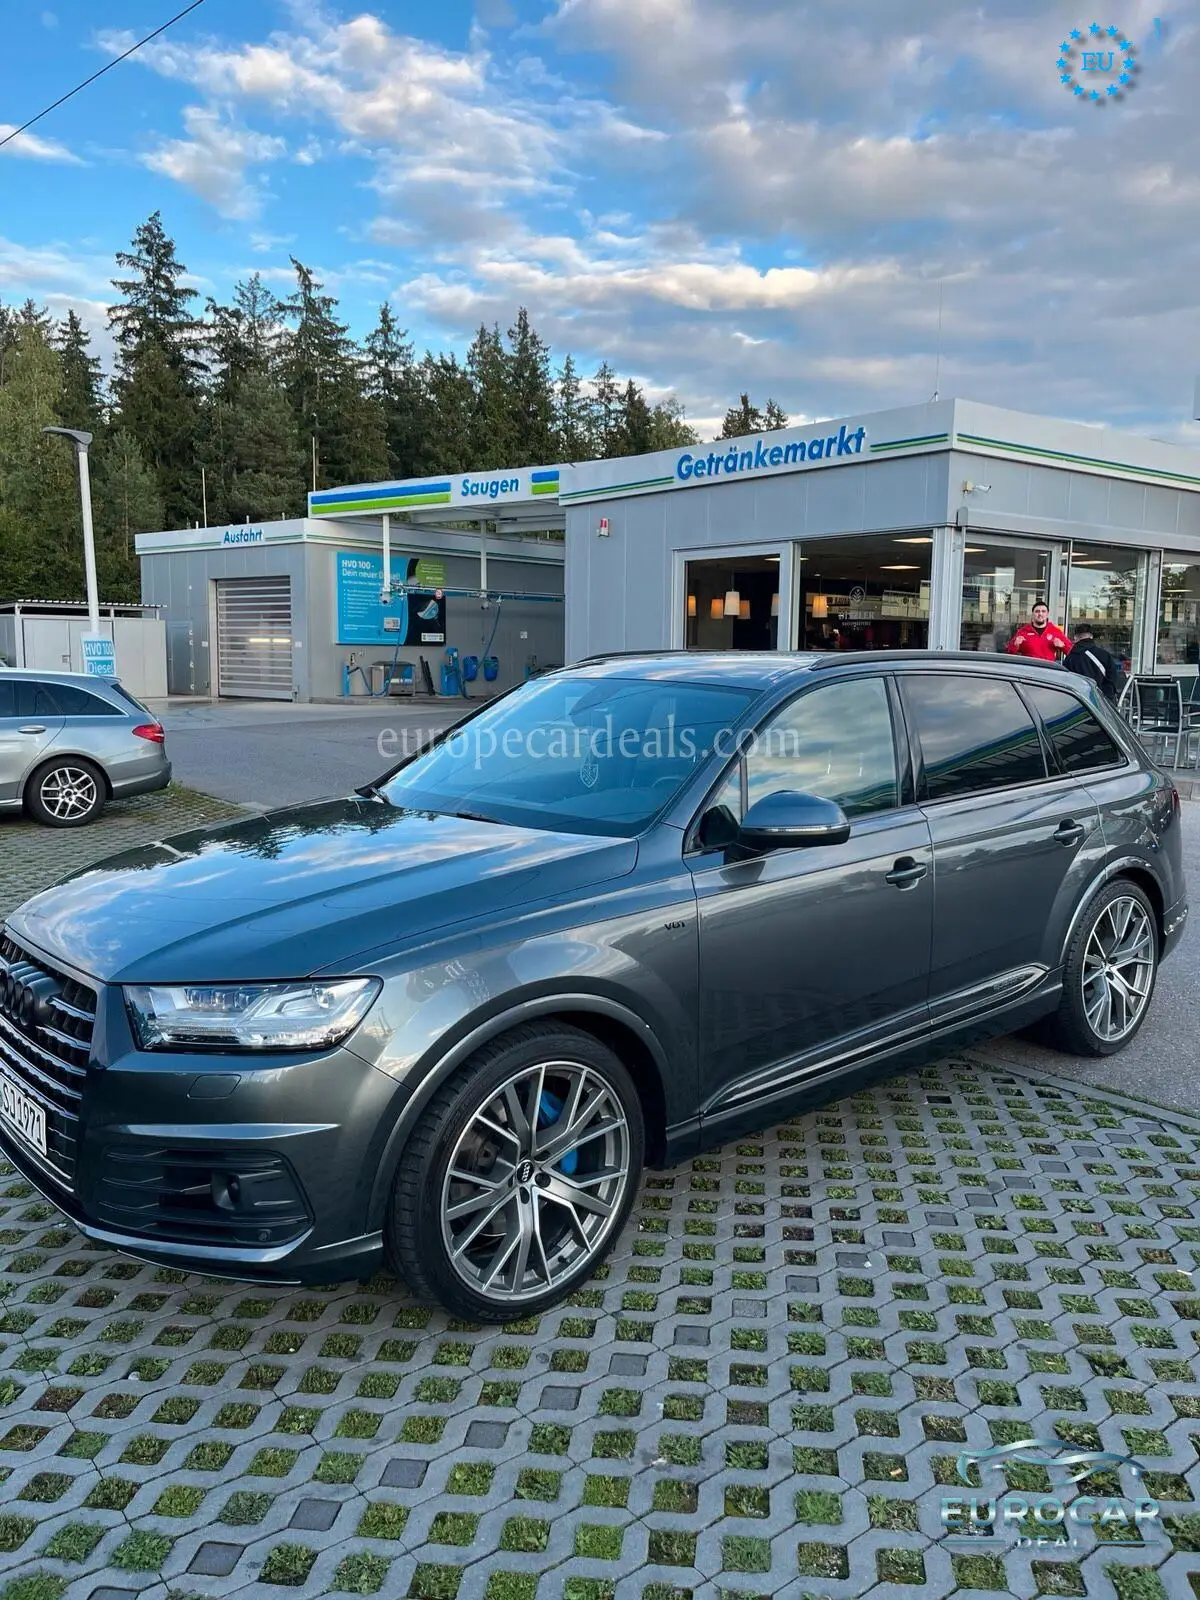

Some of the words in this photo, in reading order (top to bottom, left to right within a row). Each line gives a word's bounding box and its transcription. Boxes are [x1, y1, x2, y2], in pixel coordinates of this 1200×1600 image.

[677, 425, 866, 480] Getränkemarkt
[461, 478, 520, 499] Saugen
[223, 528, 263, 544] Ausfahrt
[341, 559, 357, 569] HVO
[358, 560, 371, 570] 100
[342, 568, 358, 577] Dein
[84, 641, 102, 656] HVO
[87, 660, 114, 674] Diesel
